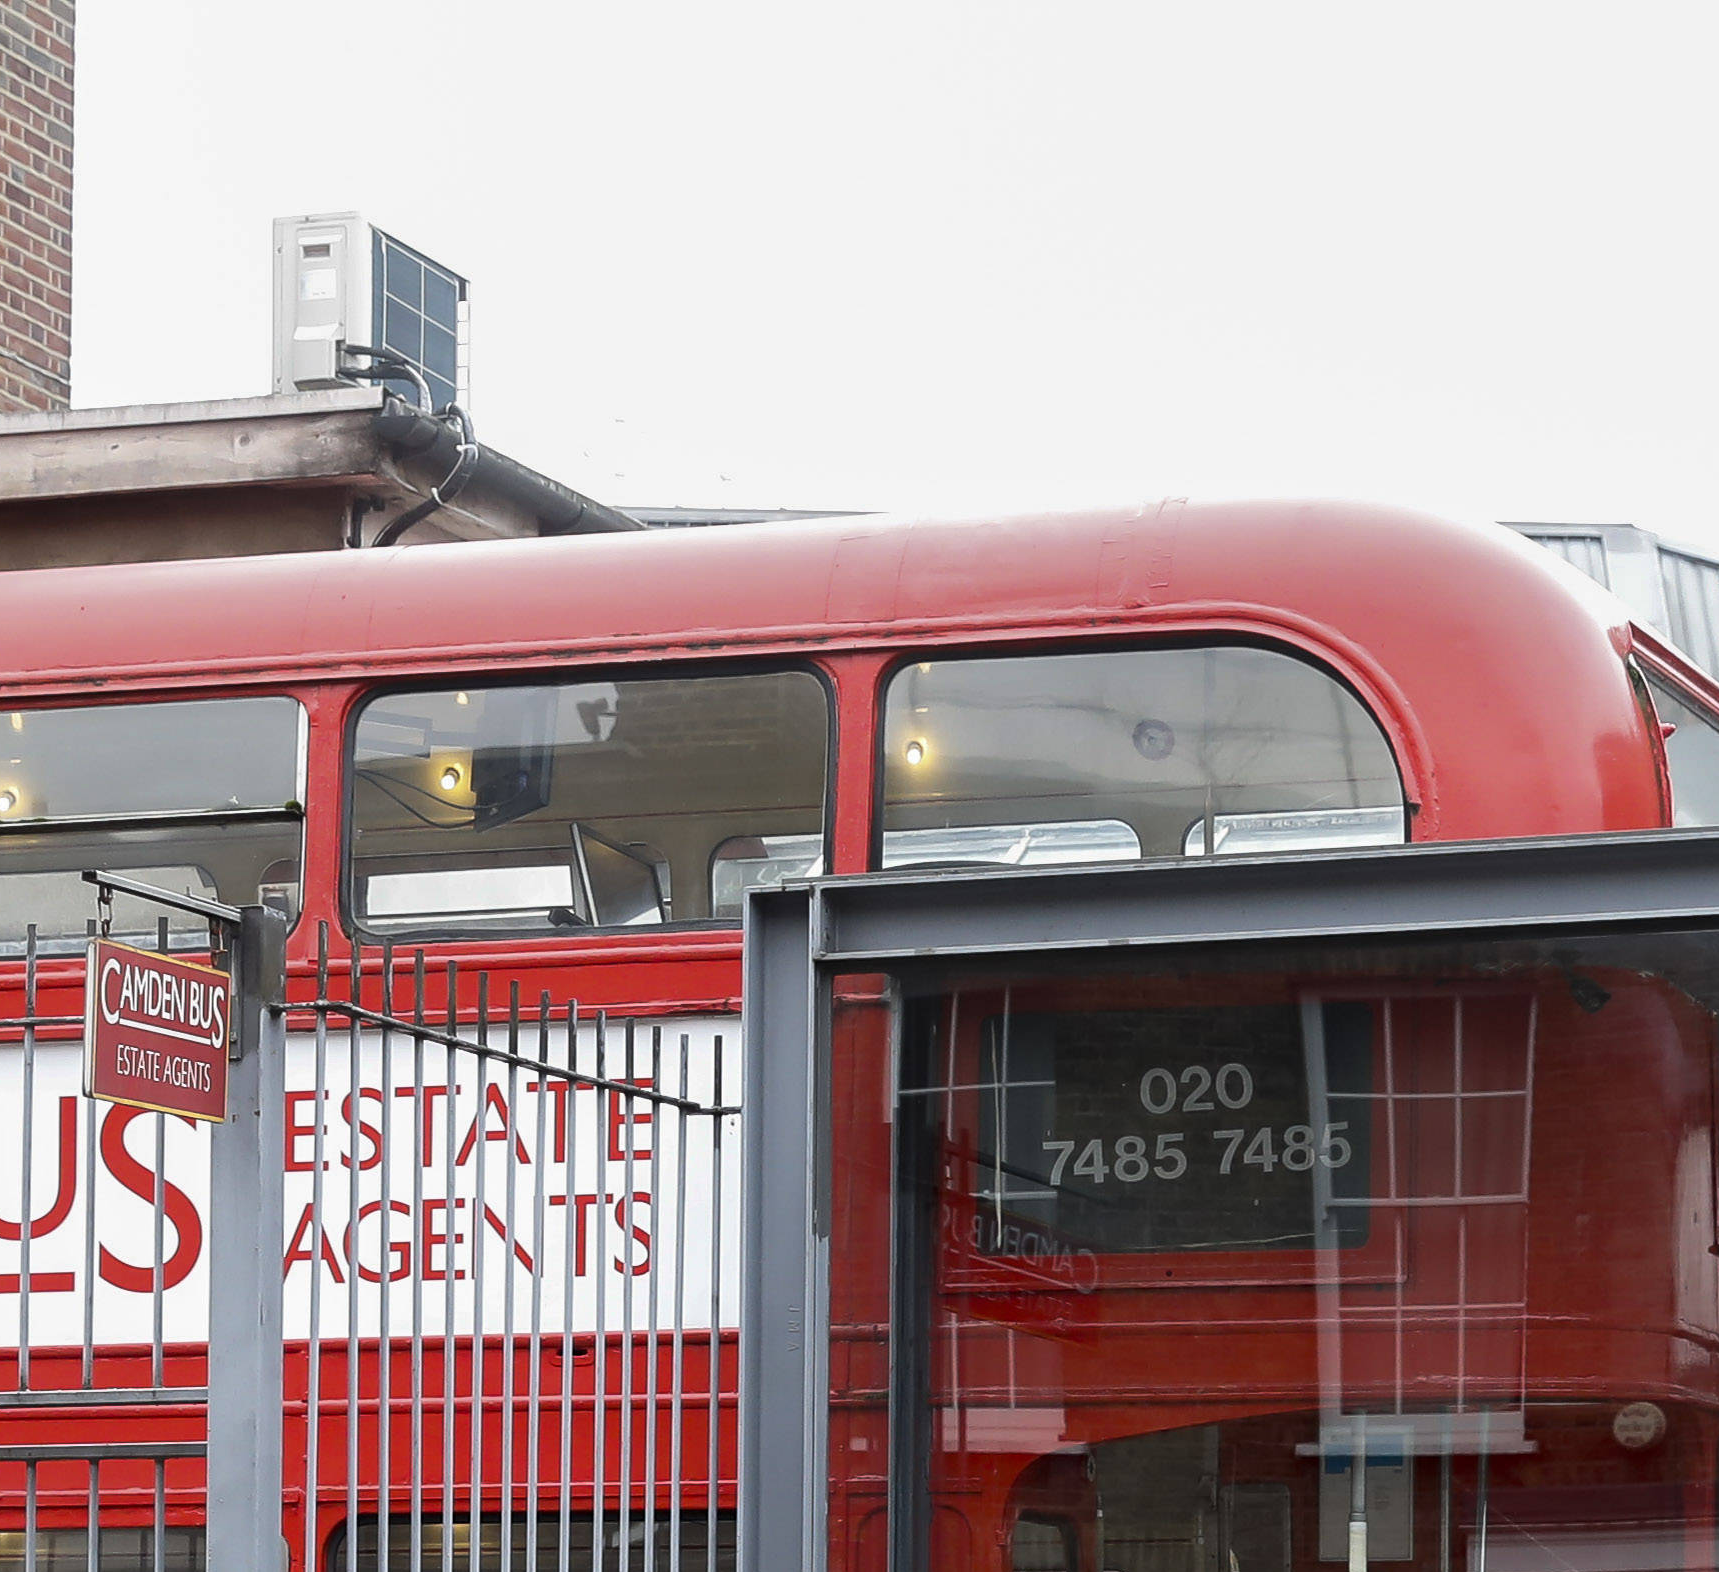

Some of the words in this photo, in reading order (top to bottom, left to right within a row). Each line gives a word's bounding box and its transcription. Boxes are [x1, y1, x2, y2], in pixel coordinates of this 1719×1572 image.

[101, 957, 185, 1026] CAMDEN
[189, 980, 225, 1049] BUS
[116, 1044, 160, 1083] ESTATE
[163, 1055, 211, 1093] AGENTS
[1139, 1062, 1255, 1115] 020
[283, 1076, 654, 1173] ESTATE
[1042, 1133, 1189, 1187] 7485
[1212, 1121, 1353, 1175] 7485
[283, 1190, 652, 1284] AGENTS
